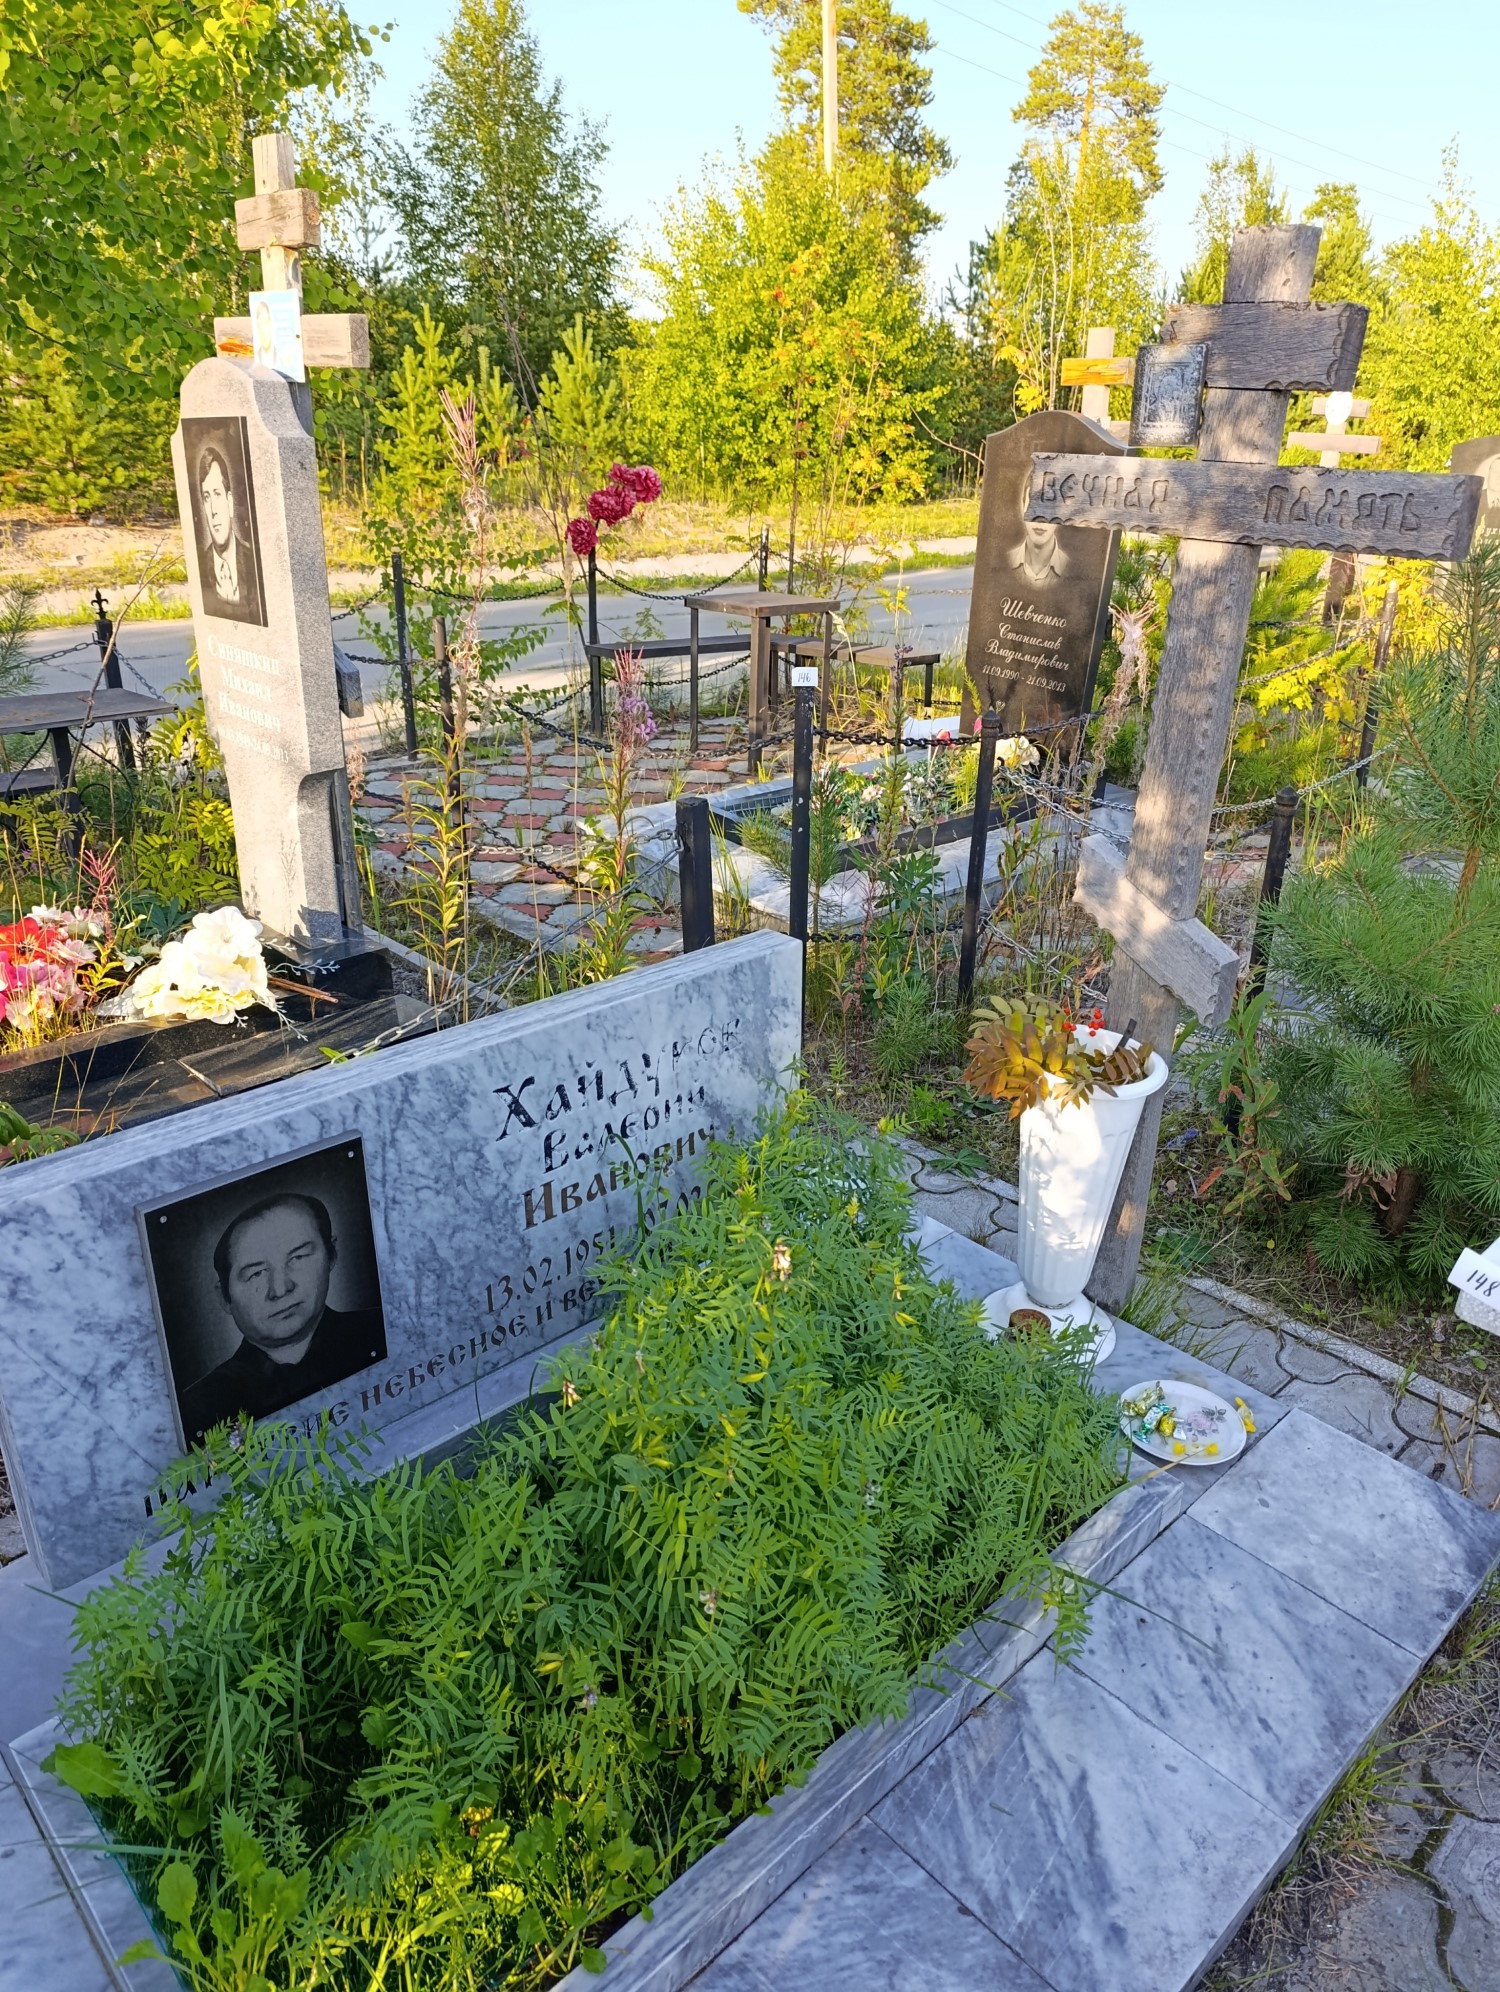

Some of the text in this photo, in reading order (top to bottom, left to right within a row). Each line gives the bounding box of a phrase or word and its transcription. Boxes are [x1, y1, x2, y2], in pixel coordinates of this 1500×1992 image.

[1040, 471, 1421, 534] ВЕЧНАЯ ПАМЯТЬ
[1000, 597, 1067, 628] Шевченко
[999, 623, 1063, 650] Станислав
[207, 634, 280, 676] Синяшкин
[985, 639, 1070, 671] Владимирович
[221, 664, 272, 702] Михаил
[797, 672, 811, 683] 146
[982, 664, 1020, 681] 11.09.1990
[1026, 675, 1067, 693] 21.09.2013
[218, 691, 281, 732] Иванович
[492, 1018, 743, 1142] Хайдуков
[543, 1079, 705, 1175] Валерий
[521, 1123, 715, 1231] Иванович
[1466, 1269, 1500, 1297] 148
[536, 1301, 554, 1326] И
